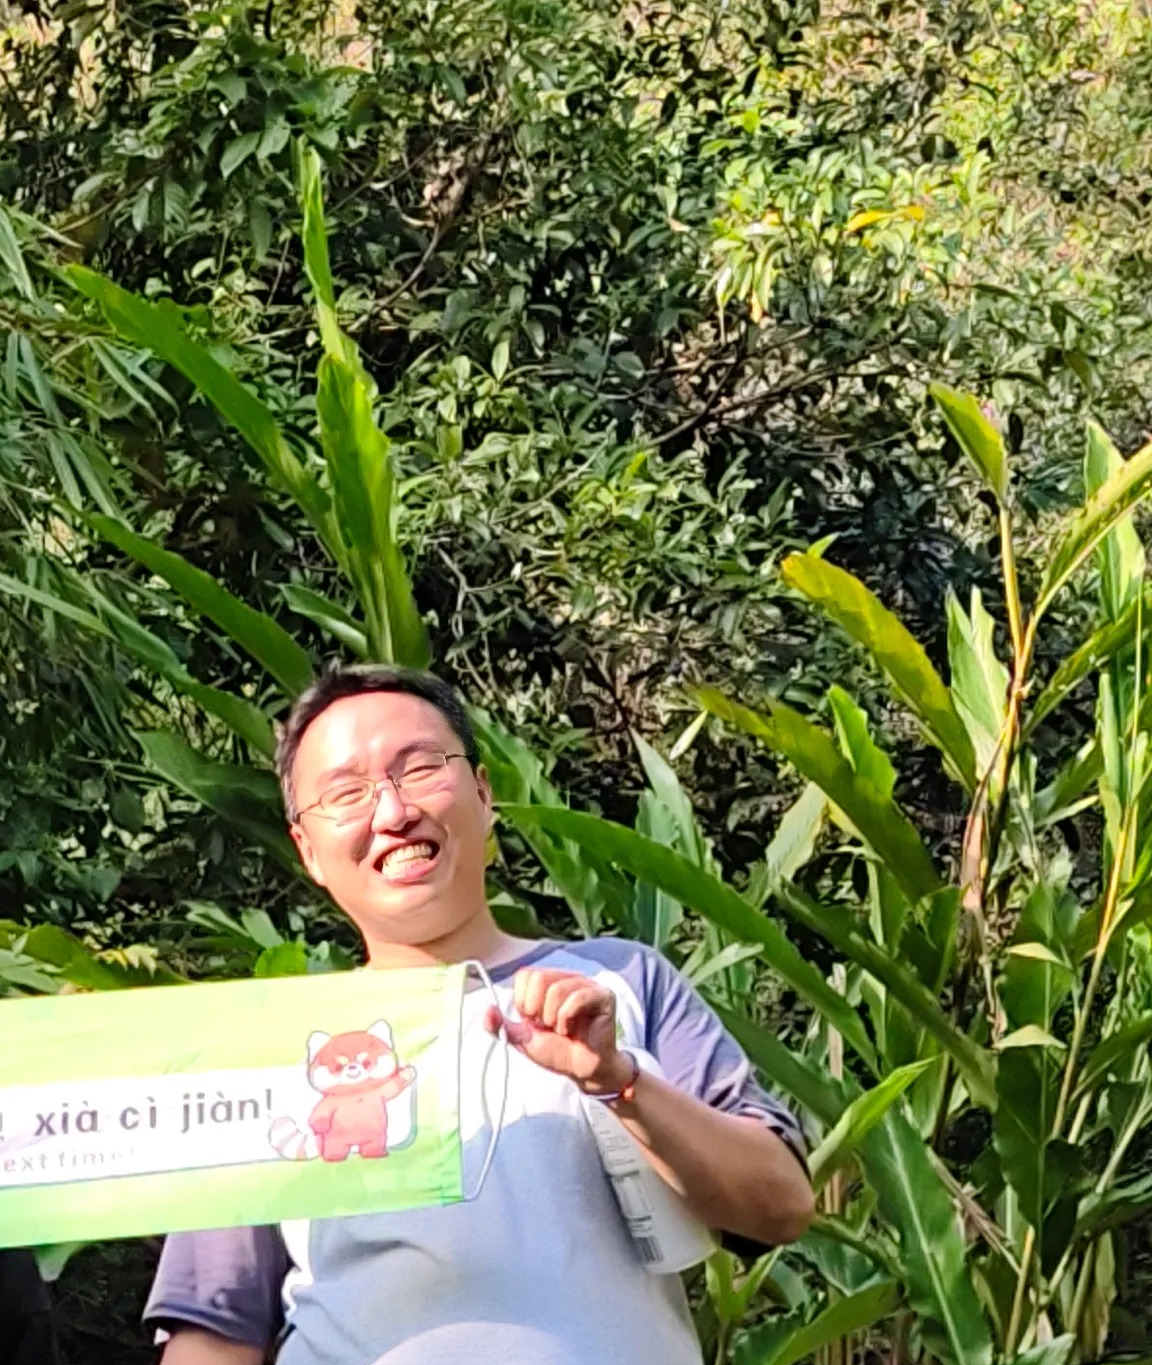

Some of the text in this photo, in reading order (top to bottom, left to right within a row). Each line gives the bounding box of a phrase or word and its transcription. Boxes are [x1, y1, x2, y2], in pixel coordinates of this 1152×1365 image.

[34, 1101, 99, 1137] xià
[119, 1095, 158, 1130] cì
[181, 1085, 274, 1133] jiàn!
